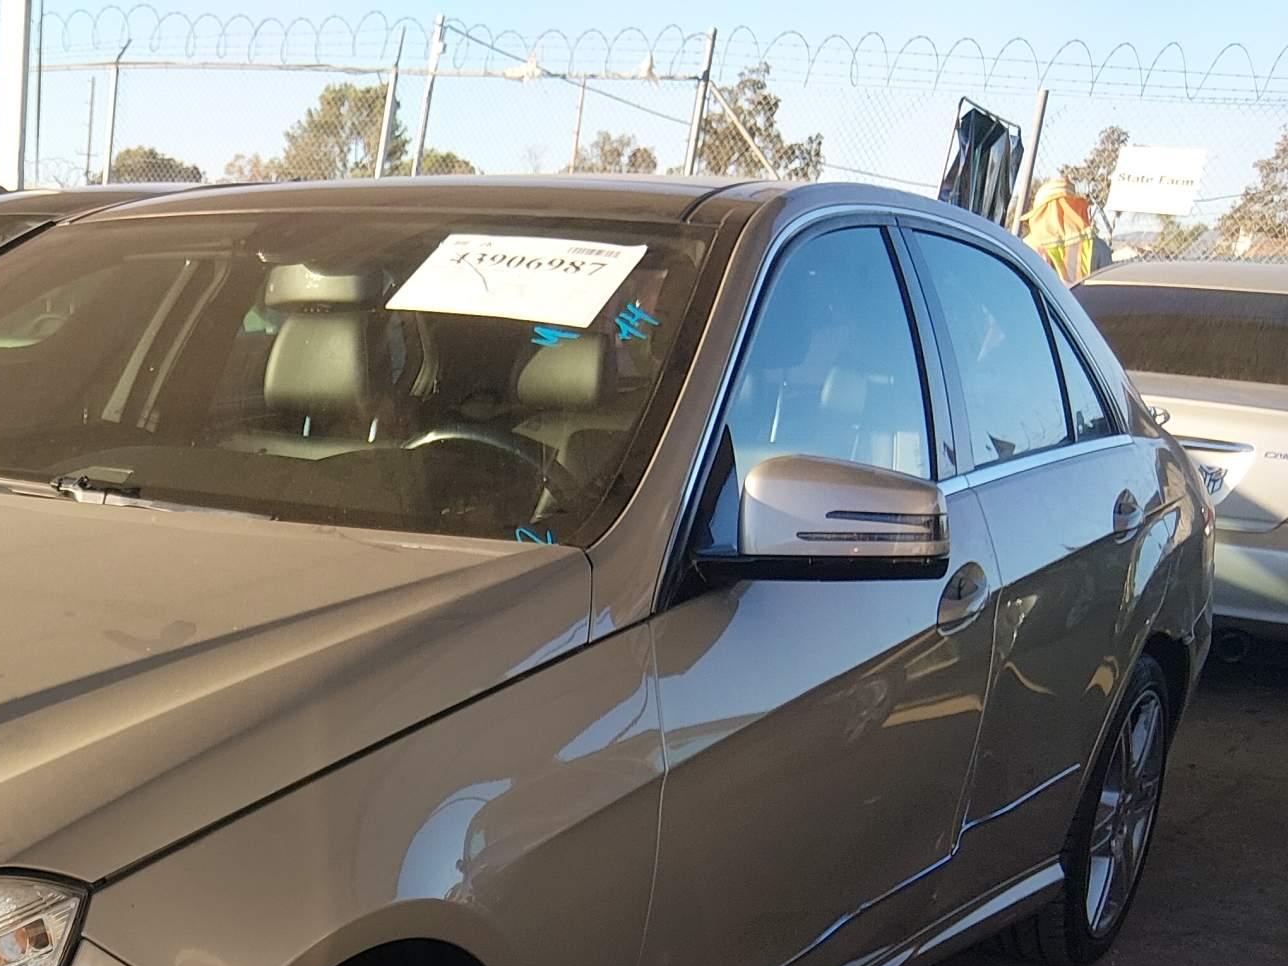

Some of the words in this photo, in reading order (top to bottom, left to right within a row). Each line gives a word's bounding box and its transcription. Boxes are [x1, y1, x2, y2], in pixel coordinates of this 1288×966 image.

[1117, 173, 1154, 184] State
[1159, 175, 1195, 186] Farm
[450, 252, 608, 276] 43906987
